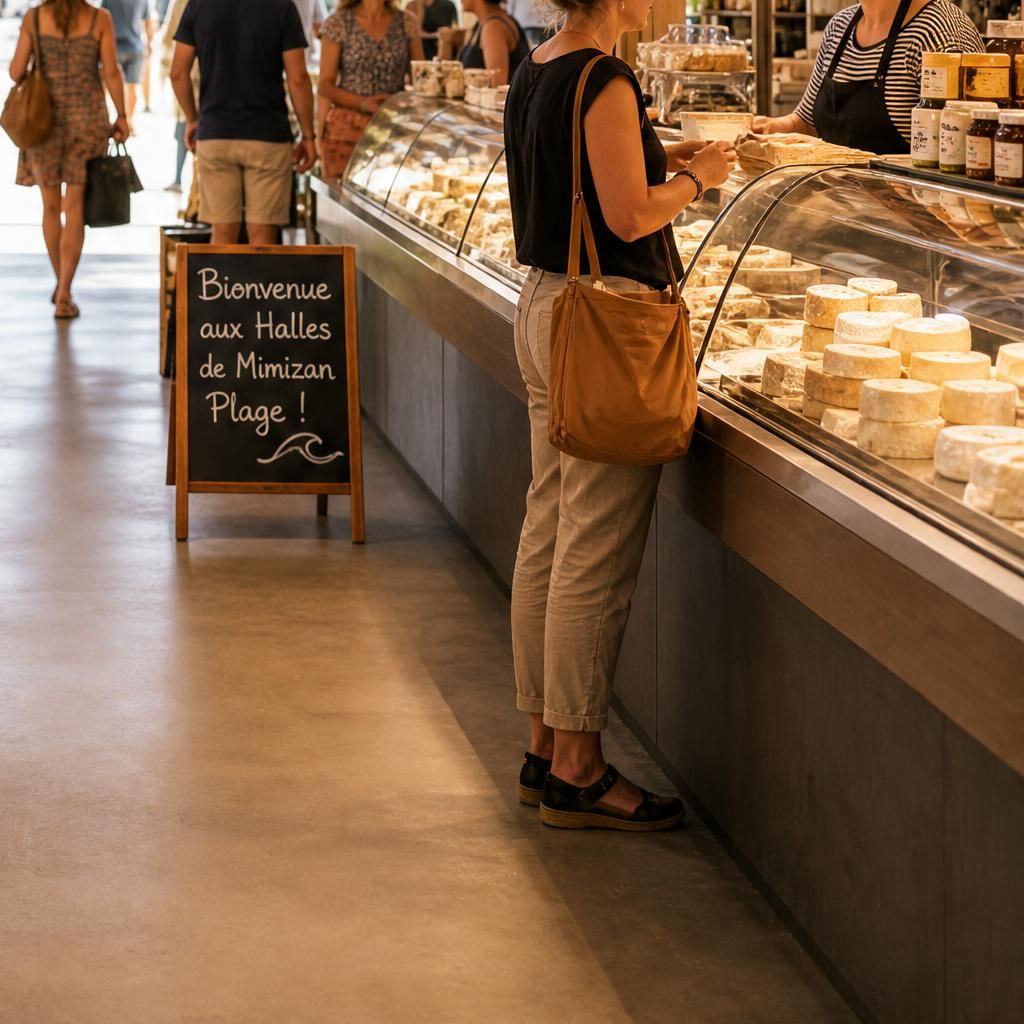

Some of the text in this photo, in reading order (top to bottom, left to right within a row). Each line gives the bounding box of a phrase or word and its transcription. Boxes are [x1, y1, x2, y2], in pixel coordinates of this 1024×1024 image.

[199, 311, 332, 340] aux Halles
[199, 351, 336, 381] de Mimizan
[205, 390, 306, 437] Plage !
